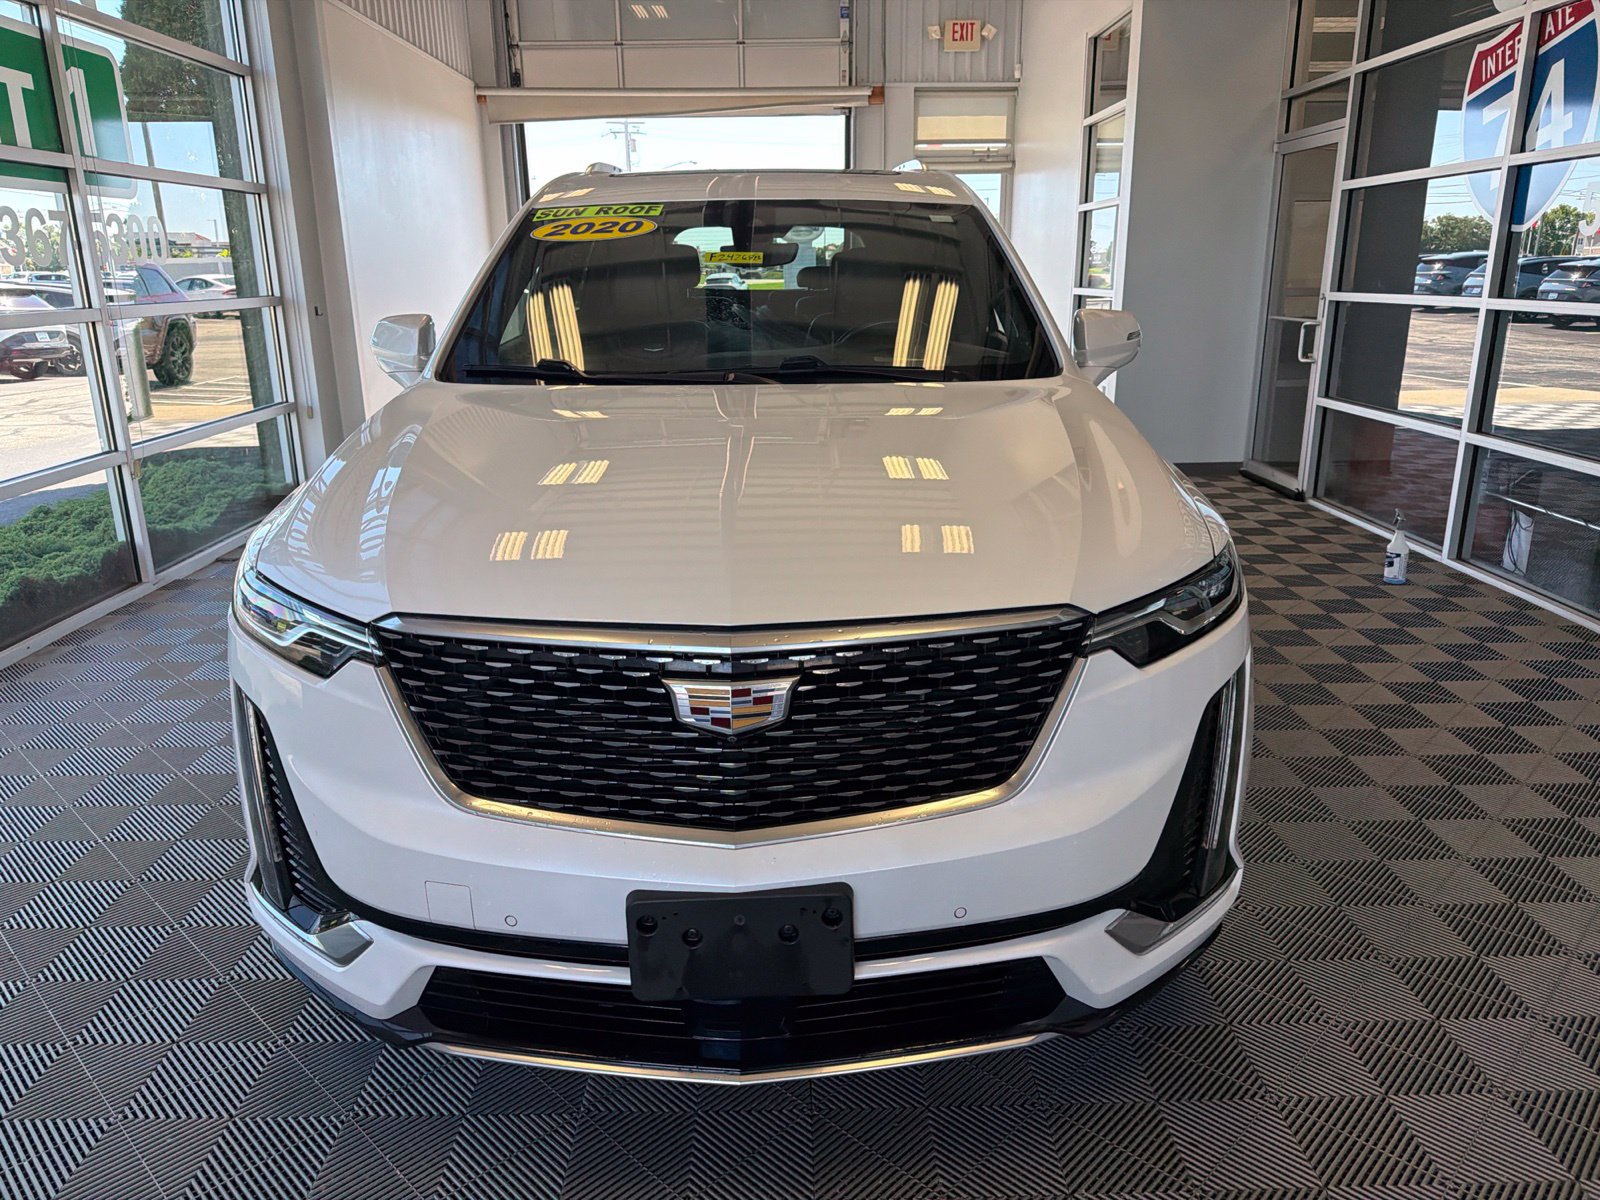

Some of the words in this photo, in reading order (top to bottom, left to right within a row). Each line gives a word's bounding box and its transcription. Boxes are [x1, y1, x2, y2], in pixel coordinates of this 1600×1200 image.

[951, 22, 976, 42] EXIT
[1482, 58, 1573, 190] 74
[536, 207, 588, 219] SUN
[595, 205, 660, 216] ROOF
[542, 220, 644, 238] 2020
